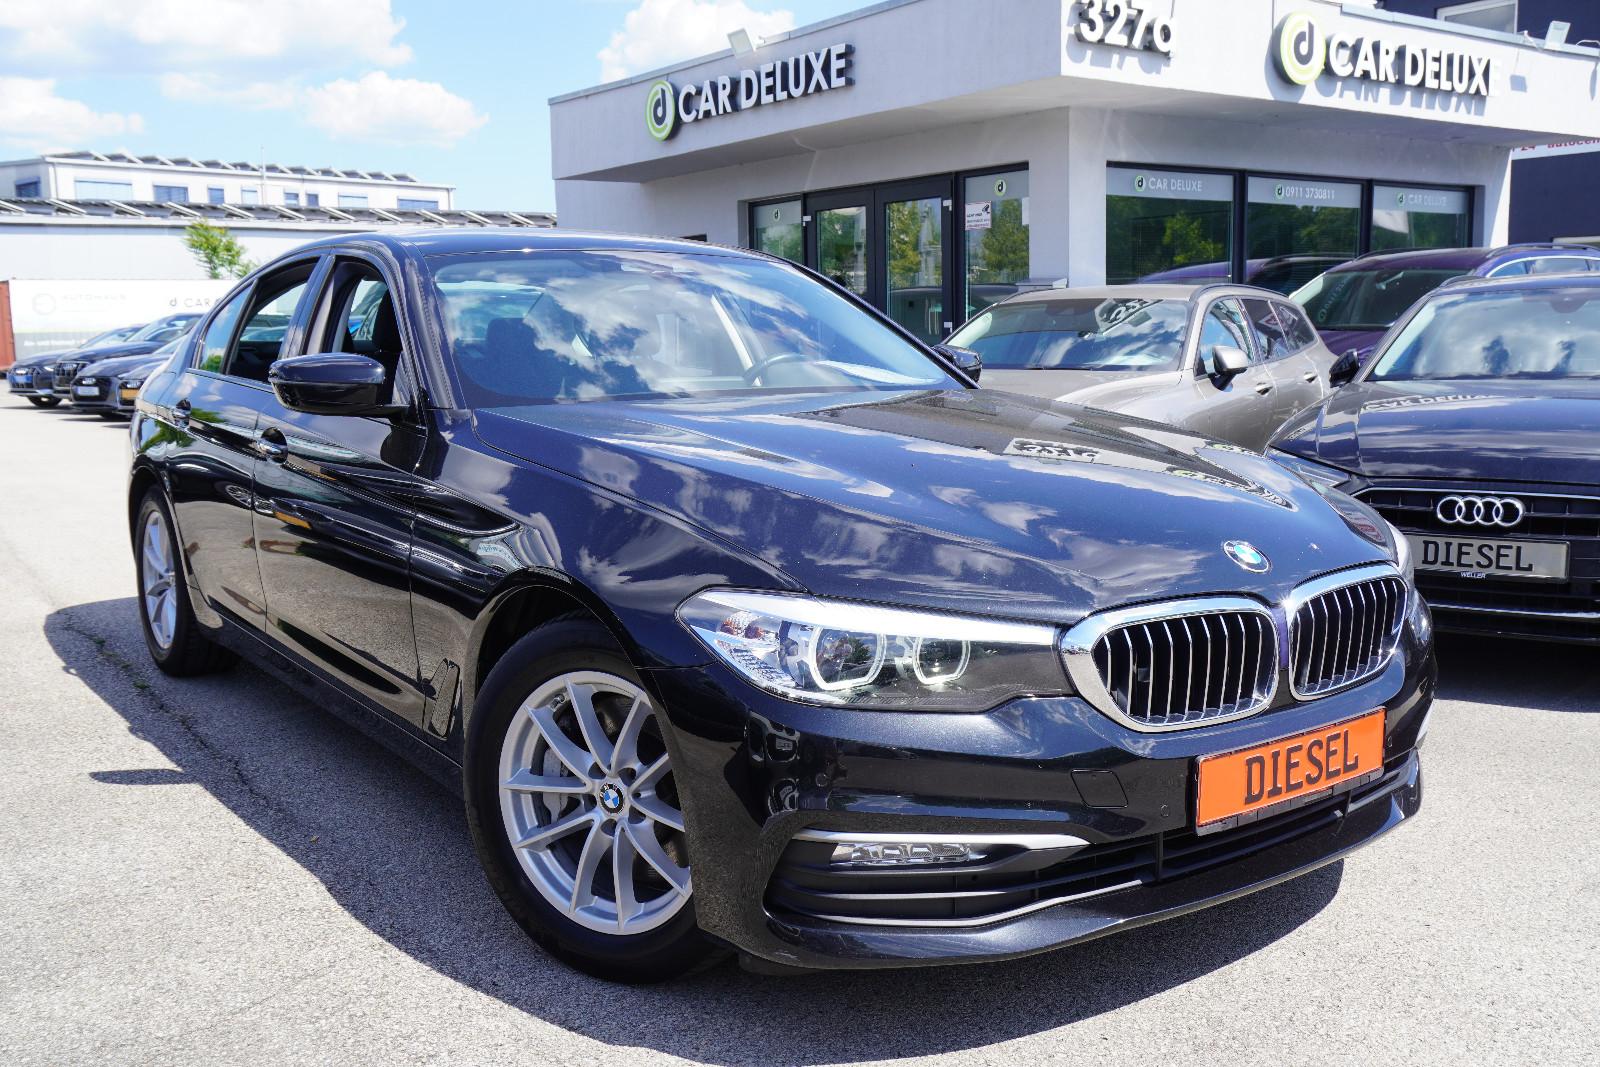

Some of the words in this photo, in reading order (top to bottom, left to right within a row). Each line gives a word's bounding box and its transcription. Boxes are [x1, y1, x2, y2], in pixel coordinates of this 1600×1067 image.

[1329, 33, 1397, 83] CAR
[678, 76, 732, 123] CAR
[740, 43, 847, 109] DELUXE
[1148, 178, 1168, 190] CAR
[1170, 179, 1203, 192] DELUXE
[1285, 186, 1303, 198] 0911
[183, 298, 211, 308] CAR
[1421, 539, 1533, 572] DIESEL
[1460, 571, 1486, 579] WELLER
[1244, 729, 1359, 805] DIESEL
